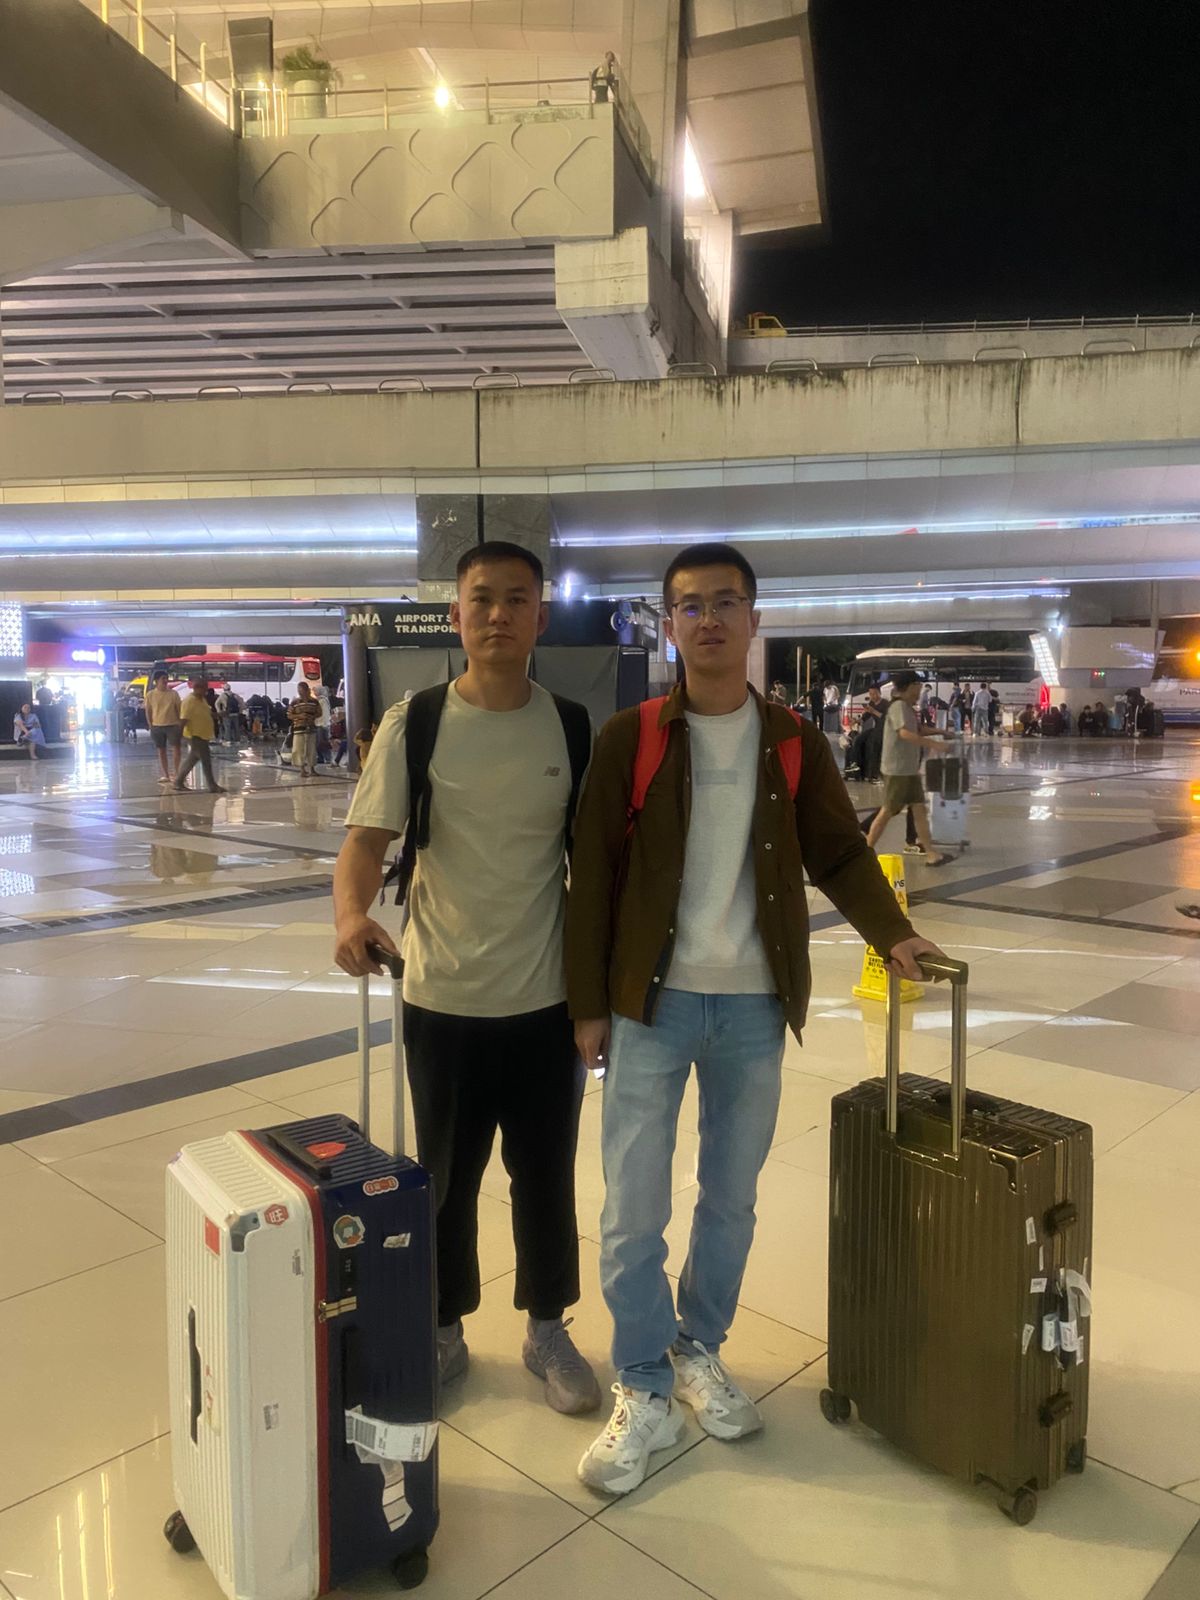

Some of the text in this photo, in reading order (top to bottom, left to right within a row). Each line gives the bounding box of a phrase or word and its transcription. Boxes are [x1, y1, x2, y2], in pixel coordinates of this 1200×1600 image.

[350, 613, 382, 626] AMA
[394, 614, 442, 622] AIRPORT
[394, 625, 457, 633] TRANSPOR
